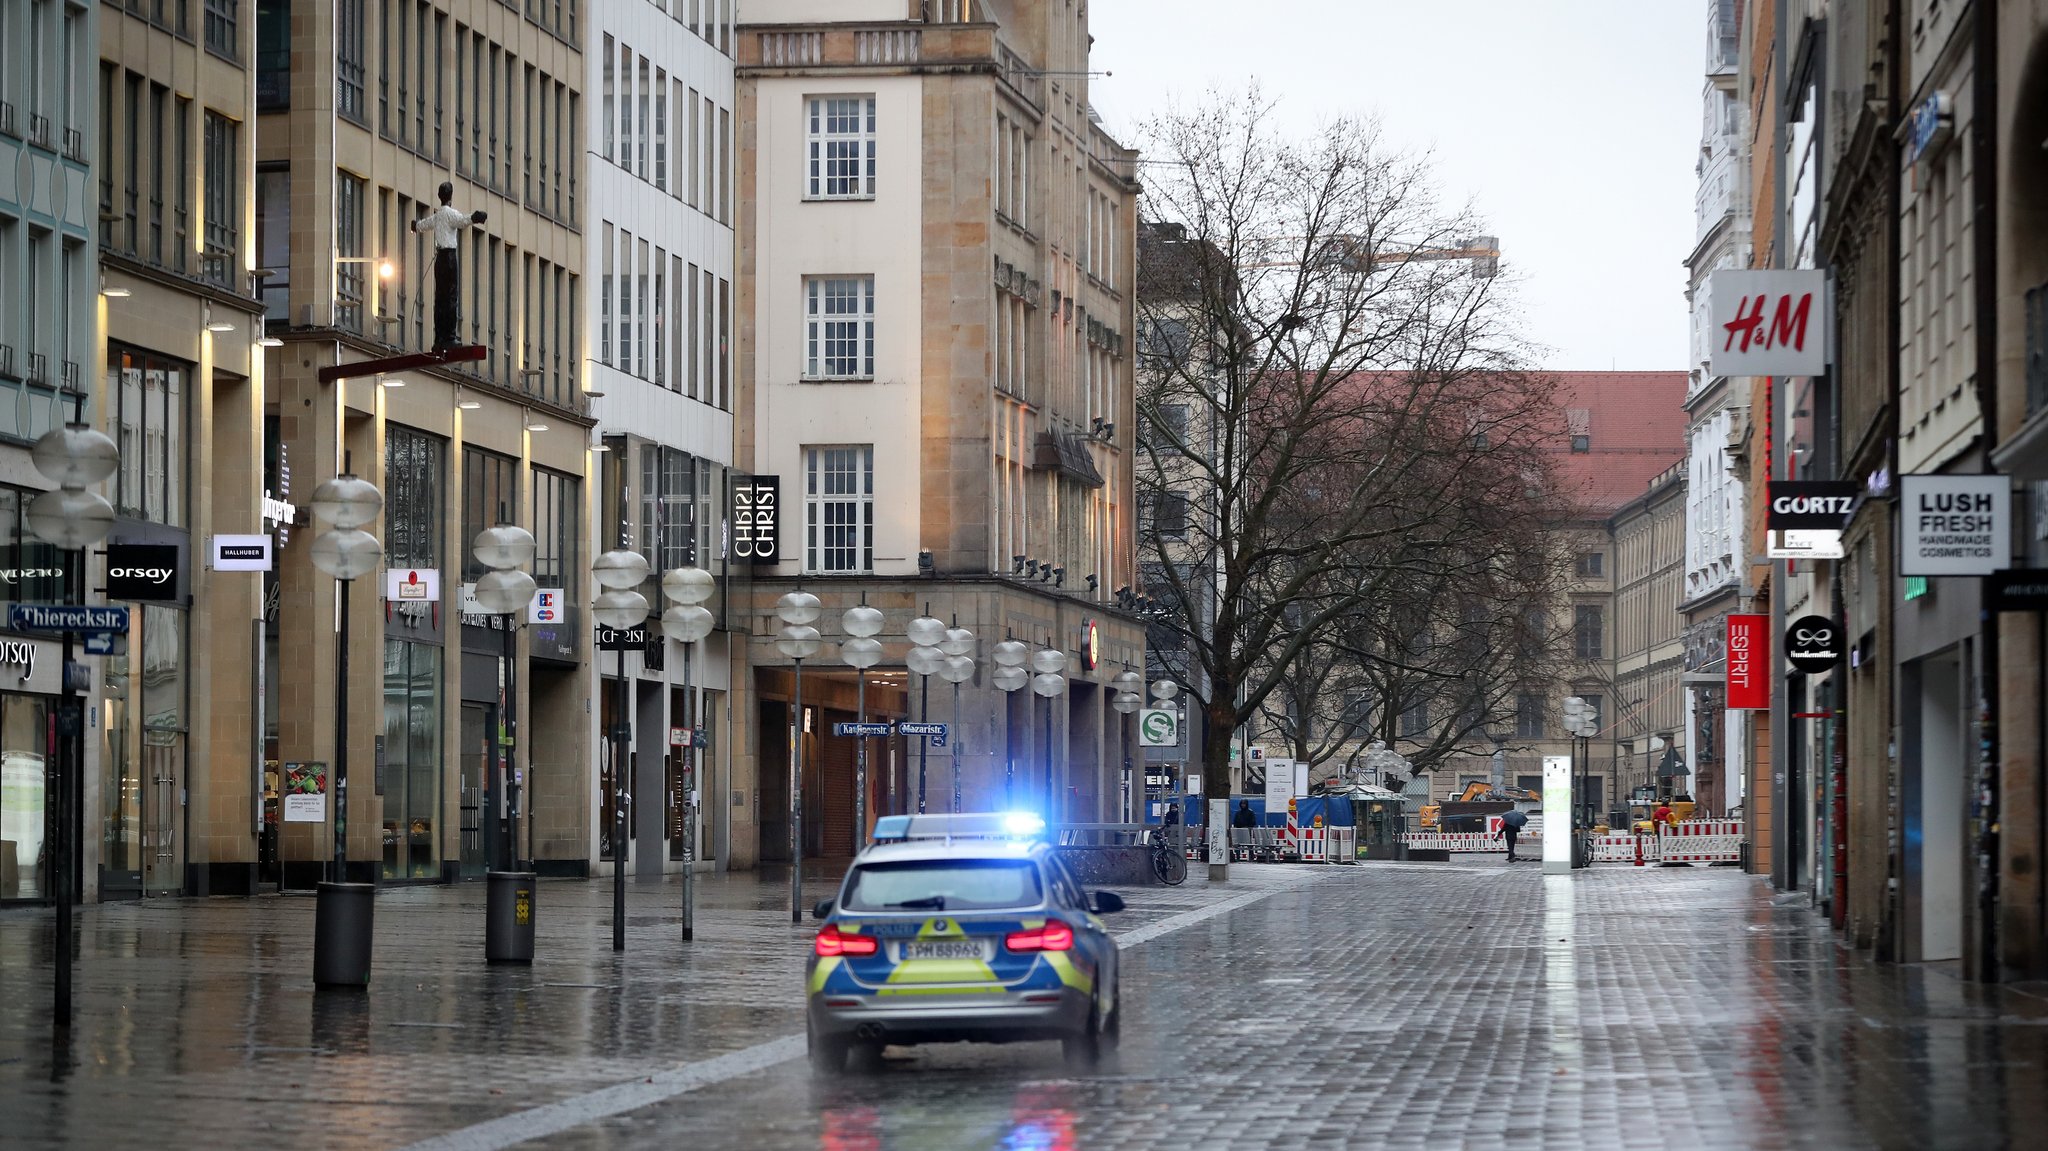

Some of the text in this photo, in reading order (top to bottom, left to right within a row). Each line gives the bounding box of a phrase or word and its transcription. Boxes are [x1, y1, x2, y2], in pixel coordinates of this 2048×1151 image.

[1723, 292, 1812, 354] H&M
[1919, 493, 1993, 513] LUSH
[755, 483, 775, 557] CHRIST
[1919, 515, 1993, 532] FRESH
[1919, 535, 1993, 545] HANDMADE
[1919, 548, 1993, 558] COSMETICS
[110, 567, 173, 584] orsay
[21, 607, 121, 628] Thiereckstr.
[1731, 624, 1749, 689] ESPRIT
[1145, 775, 1170, 785] ER
